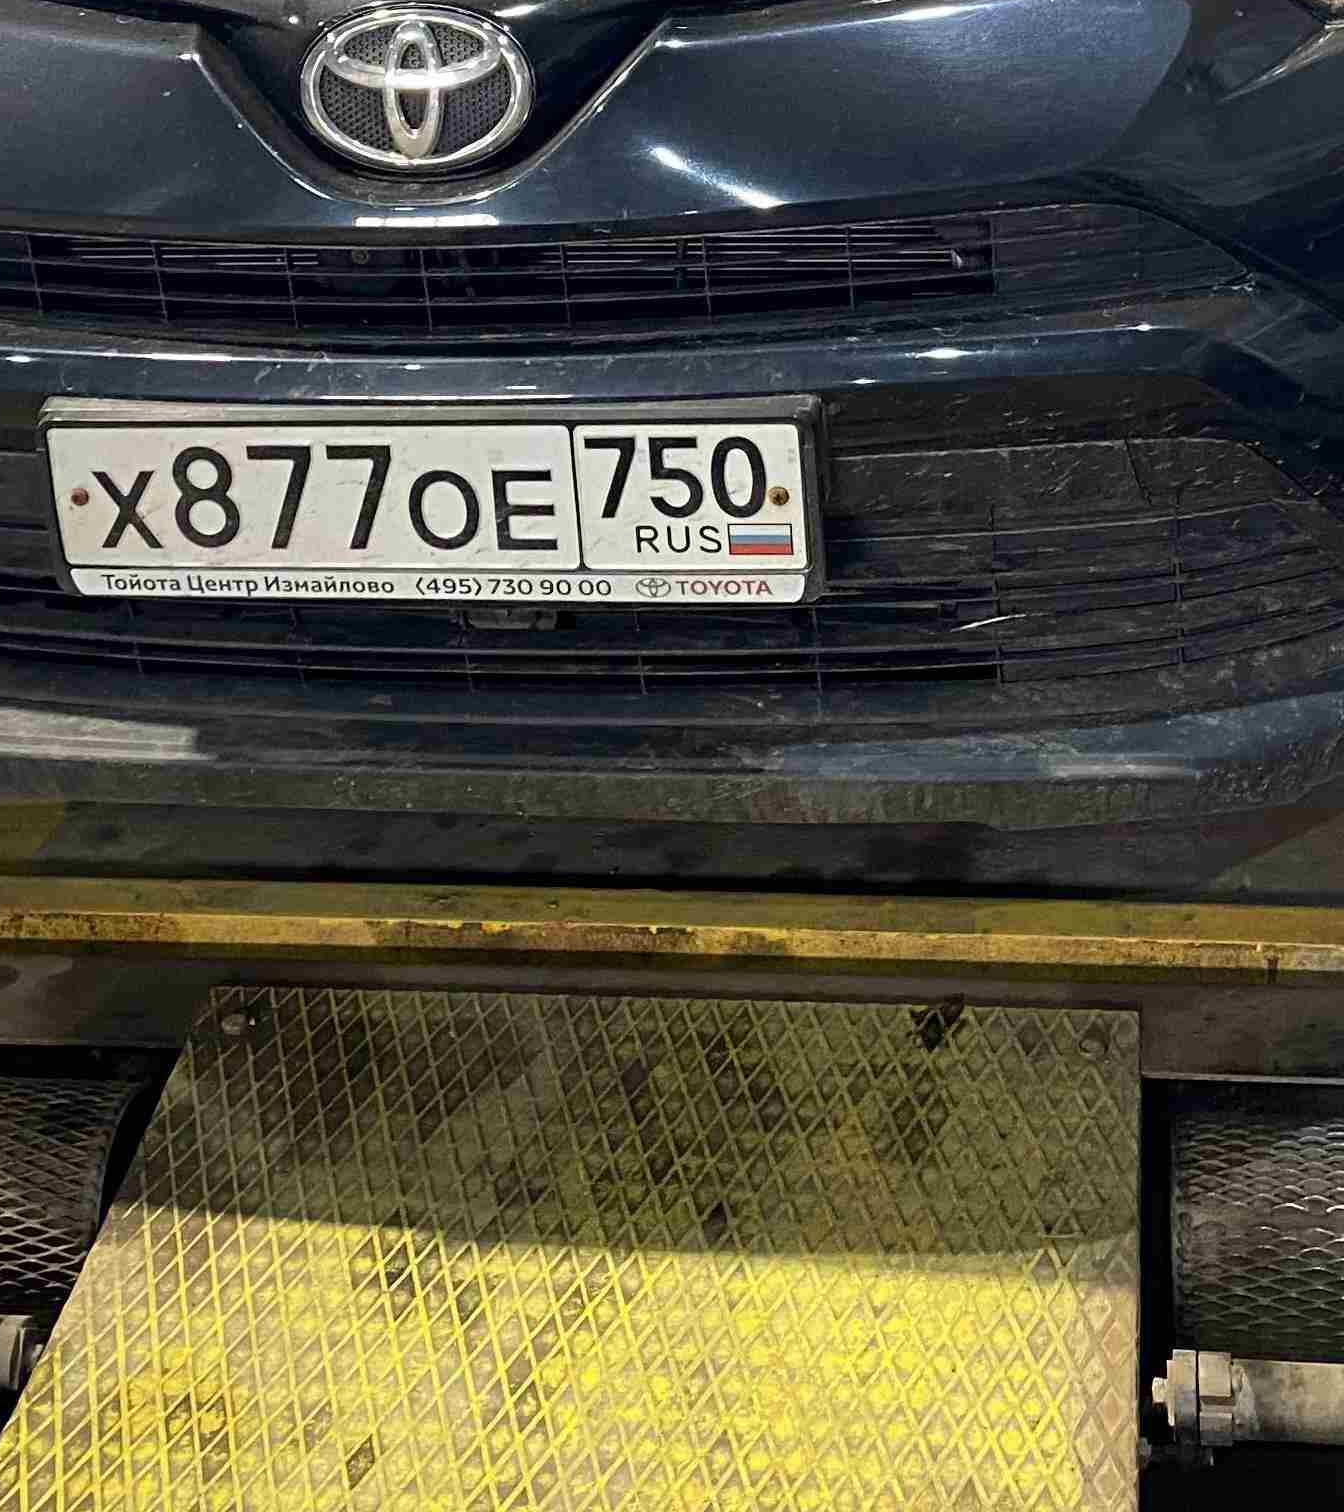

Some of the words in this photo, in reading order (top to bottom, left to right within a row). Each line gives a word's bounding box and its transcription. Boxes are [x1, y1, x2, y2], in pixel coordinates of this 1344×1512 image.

[583, 436, 767, 519] 750
[635, 525, 722, 554] RUS
[102, 574, 181, 593] Тойота
[186, 575, 259, 596] Центр
[264, 575, 394, 594] Измайлово
[415, 577, 482, 597] (495)
[487, 578, 533, 595] 730
[539, 579, 572, 596] 90
[576, 579, 612, 596] 00
[675, 579, 773, 596] TOYOTA
